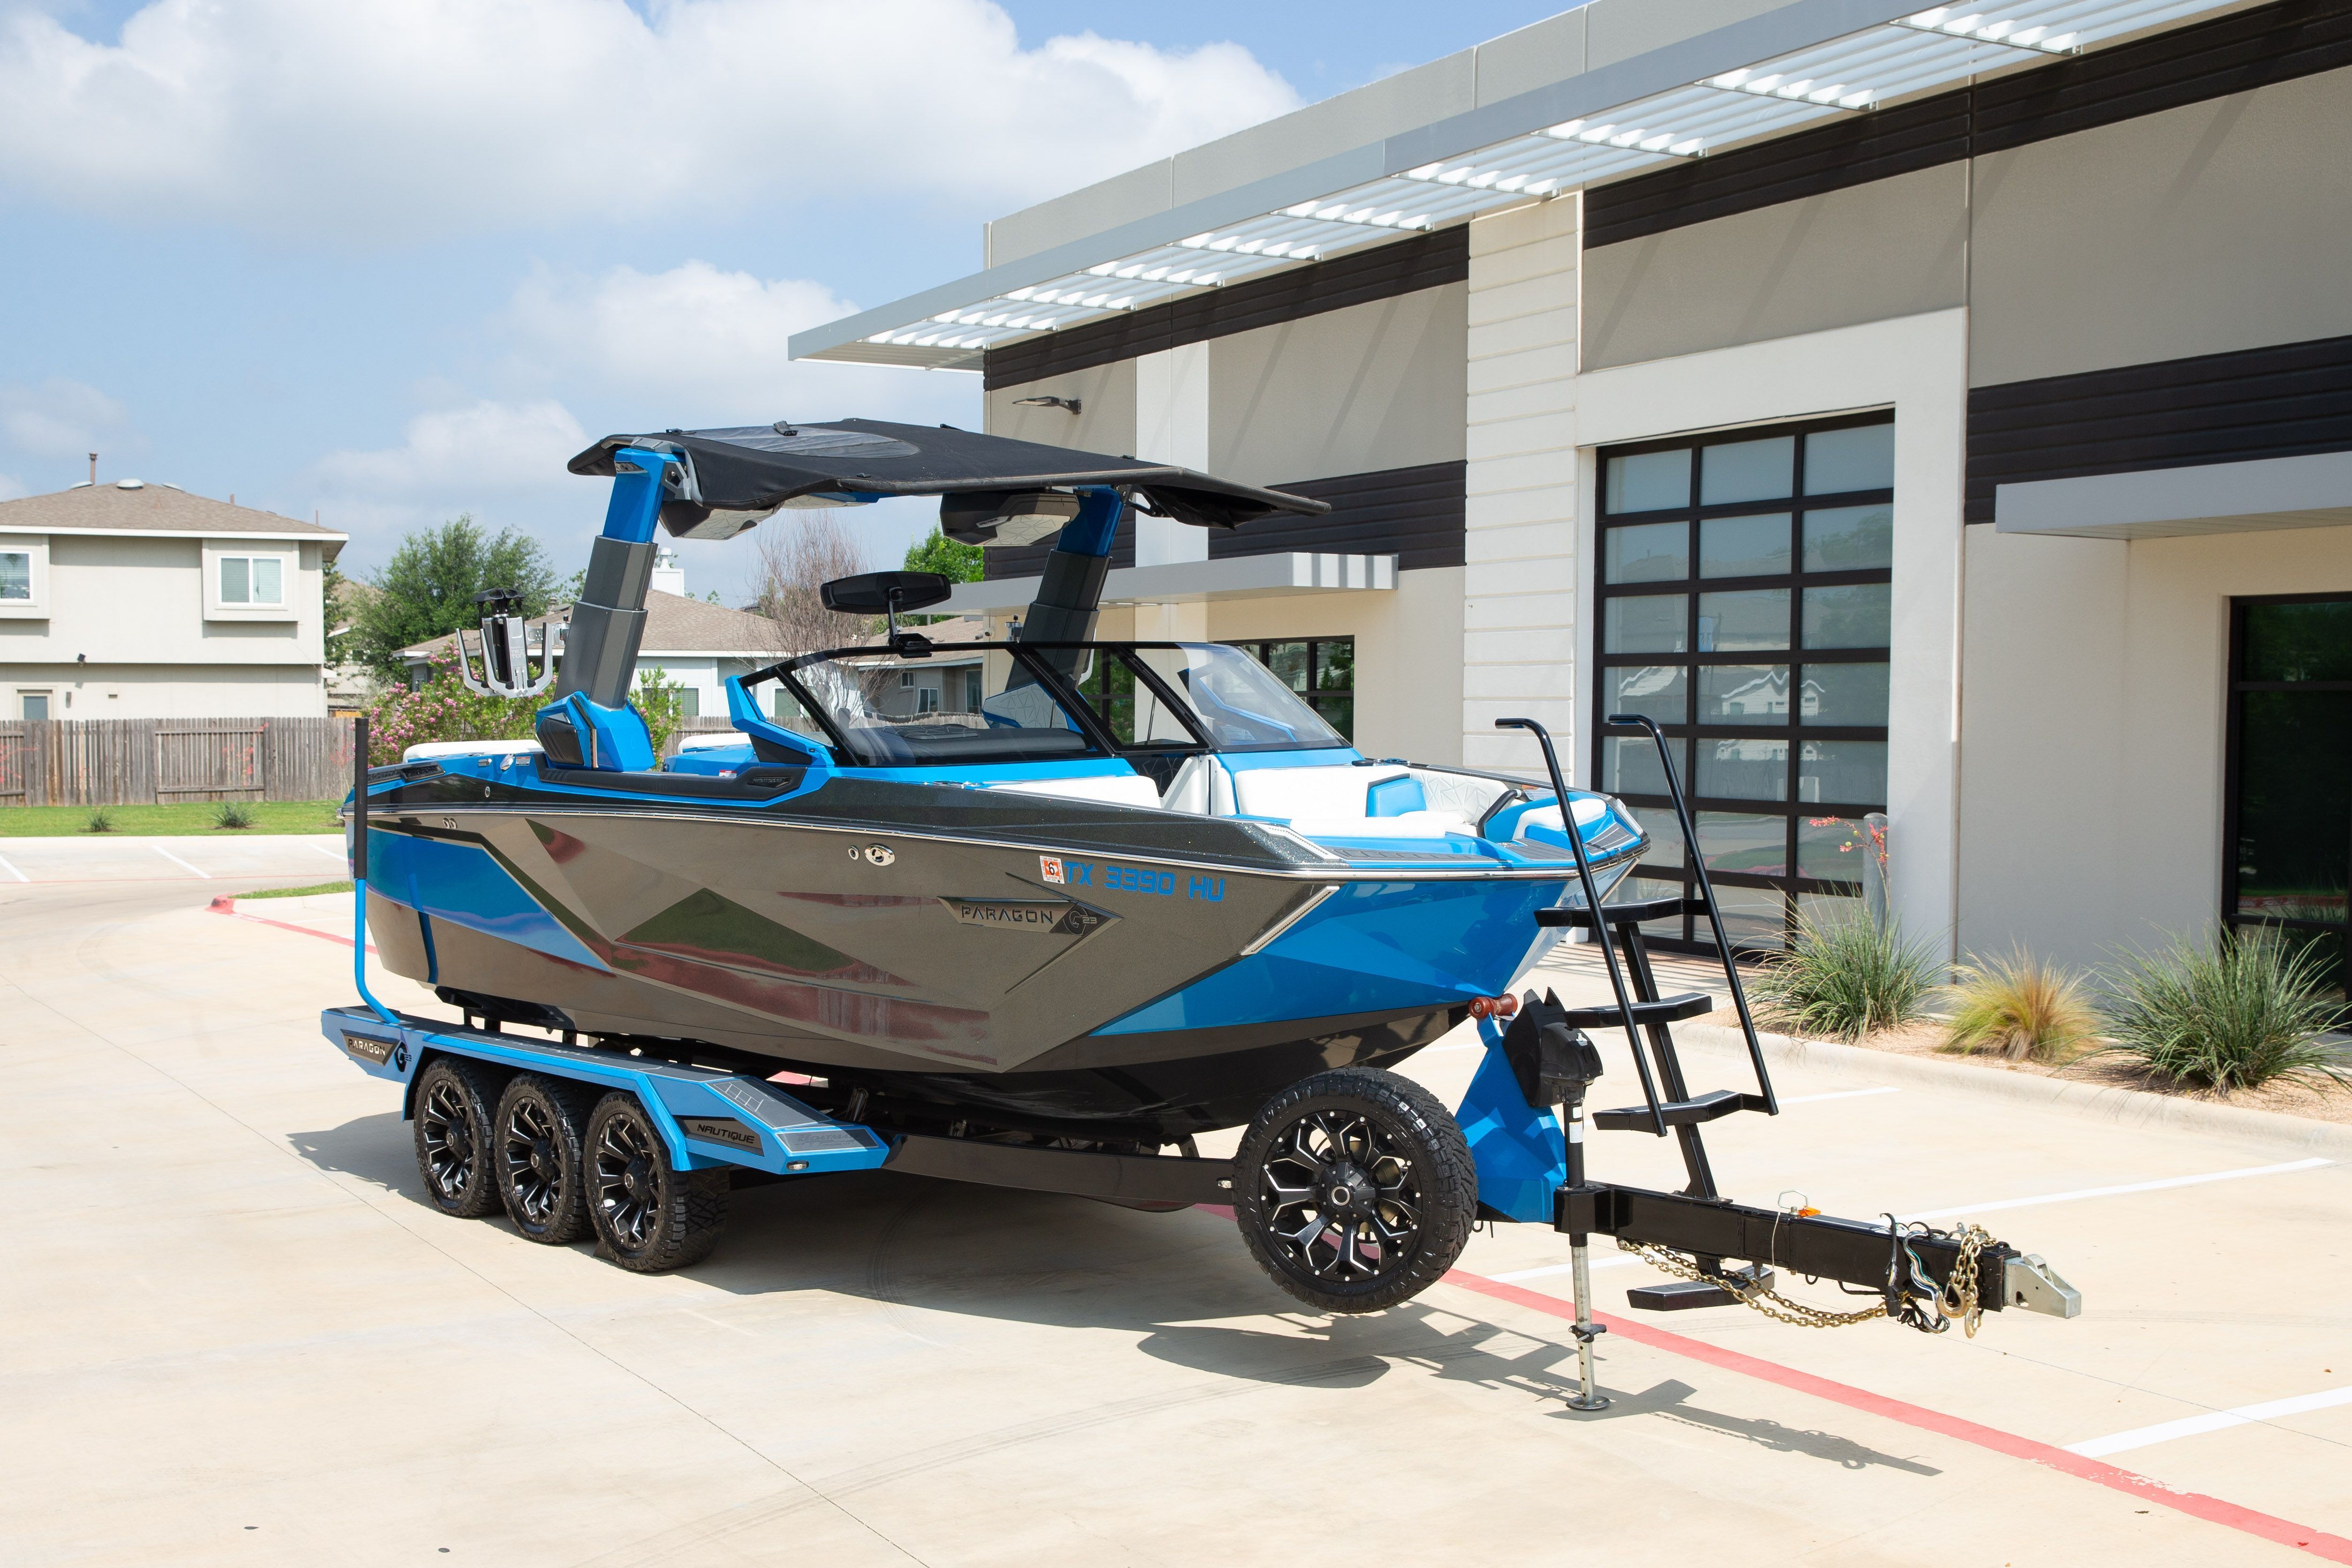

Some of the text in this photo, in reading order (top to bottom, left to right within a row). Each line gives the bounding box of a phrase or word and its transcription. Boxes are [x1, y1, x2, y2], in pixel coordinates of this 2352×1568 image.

[1048, 862, 1055, 876] 6
[1063, 861, 1224, 902] TX 3390 HU
[960, 904, 1053, 924] PARAGON
[348, 1038, 386, 1056] PARAGON
[697, 1123, 755, 1144] NAUTIQUE
